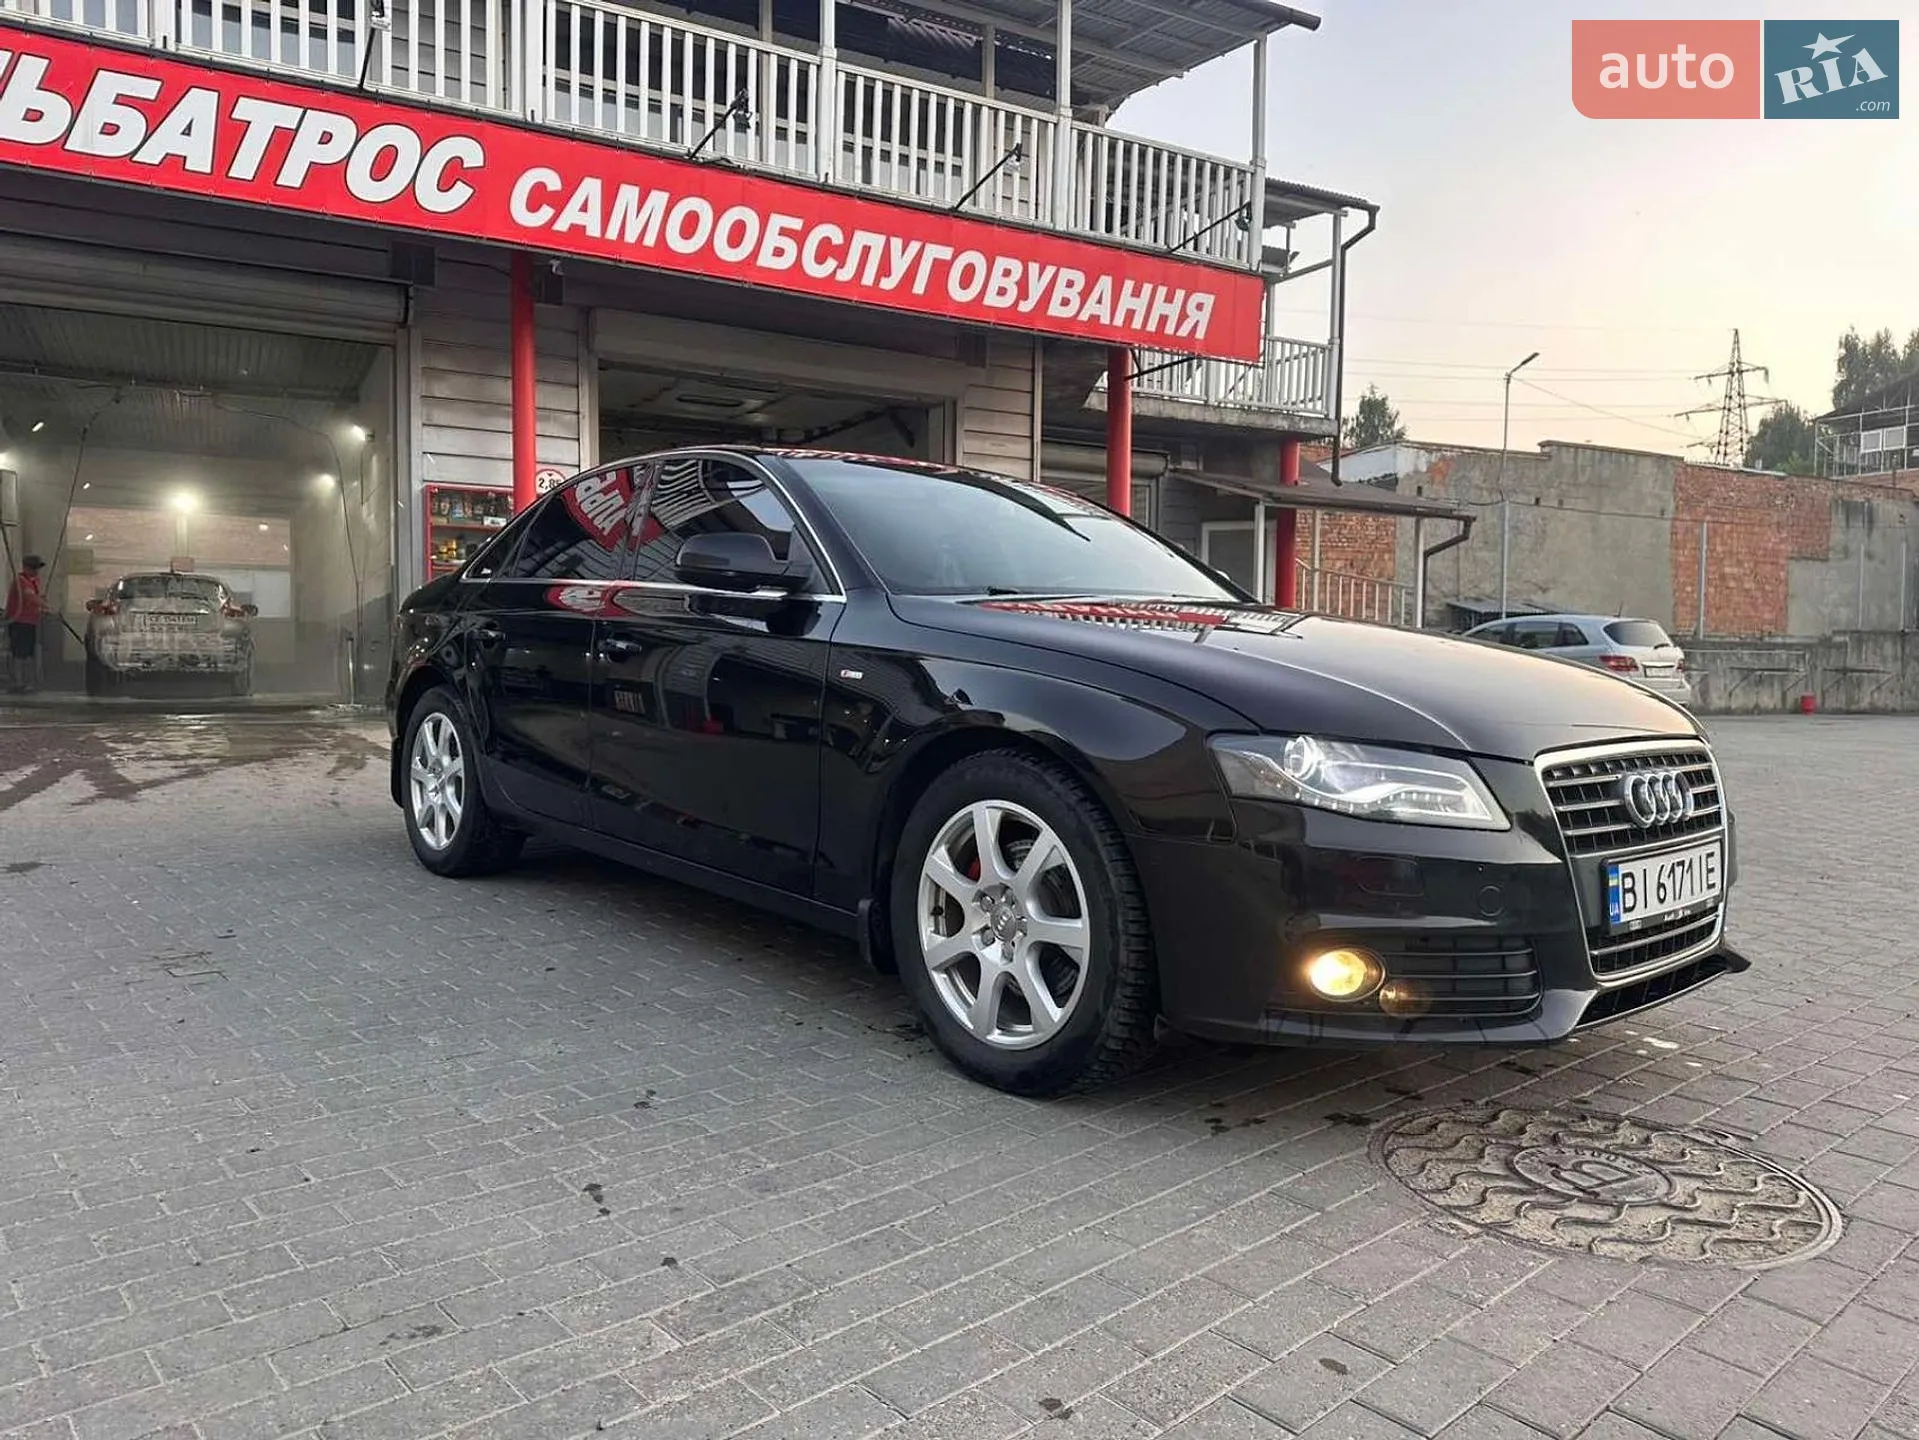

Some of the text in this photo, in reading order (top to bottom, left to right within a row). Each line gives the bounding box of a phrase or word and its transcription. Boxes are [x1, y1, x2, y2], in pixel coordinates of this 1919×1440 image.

[0, 48, 1216, 340] ЬБАТРОС САМООБСЛУГОВУВАННЯ
[1609, 901, 1620, 917] UA
